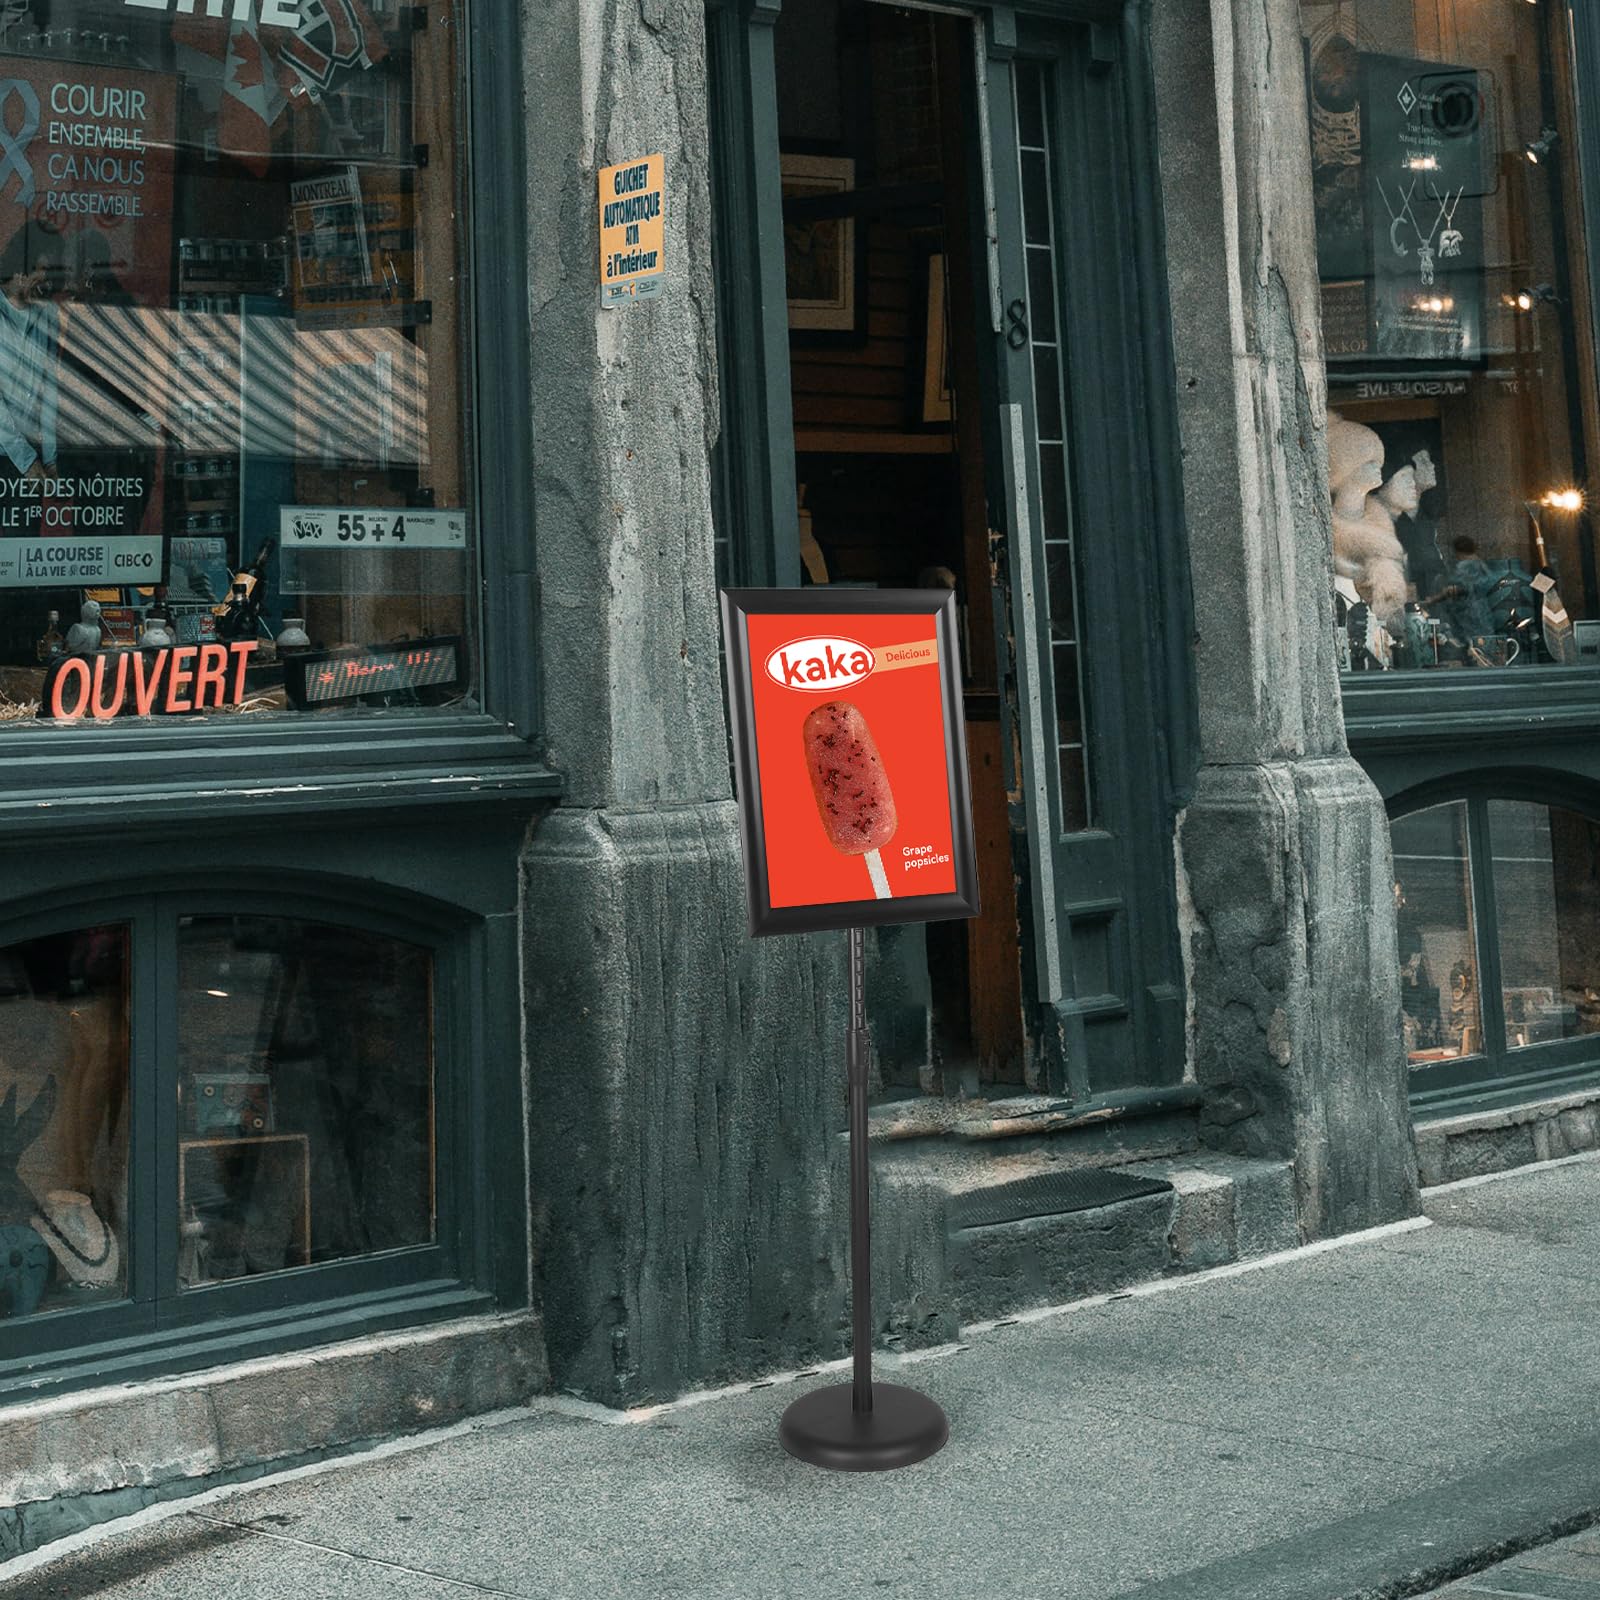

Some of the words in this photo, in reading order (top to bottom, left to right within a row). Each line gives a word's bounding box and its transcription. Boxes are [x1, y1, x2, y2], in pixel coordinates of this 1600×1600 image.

[51, 83, 146, 120] COURIR
[49, 122, 146, 154] ENSEMBLE,
[48, 153, 79, 185] ÇA
[84, 156, 145, 184] NOUS
[614, 163, 648, 195] GUICHET
[604, 191, 660, 229] AUTOMATIQUE
[607, 255, 613, 277] à
[614, 248, 657, 276] l'intérieur
[44, 478, 74, 497] DES
[78, 472, 143, 497] NÔTRES
[2, 507, 20, 526] LE
[45, 506, 124, 526] OCTOBRE
[337, 514, 366, 541] 55
[392, 515, 406, 542] 4
[26, 548, 43, 562] LA
[46, 547, 104, 562] COURSE
[114, 554, 141, 567] CIBC
[26, 563, 33, 577] À
[36, 566, 47, 577] LA
[50, 566, 66, 576] VIE
[79, 565, 103, 576] CIBC
[779, 645, 870, 685] kaka
[885, 647, 931, 663] Delicious
[51, 641, 258, 719] OUVERT
[902, 844, 933, 858] Grape
[904, 852, 950, 871] popsicles
